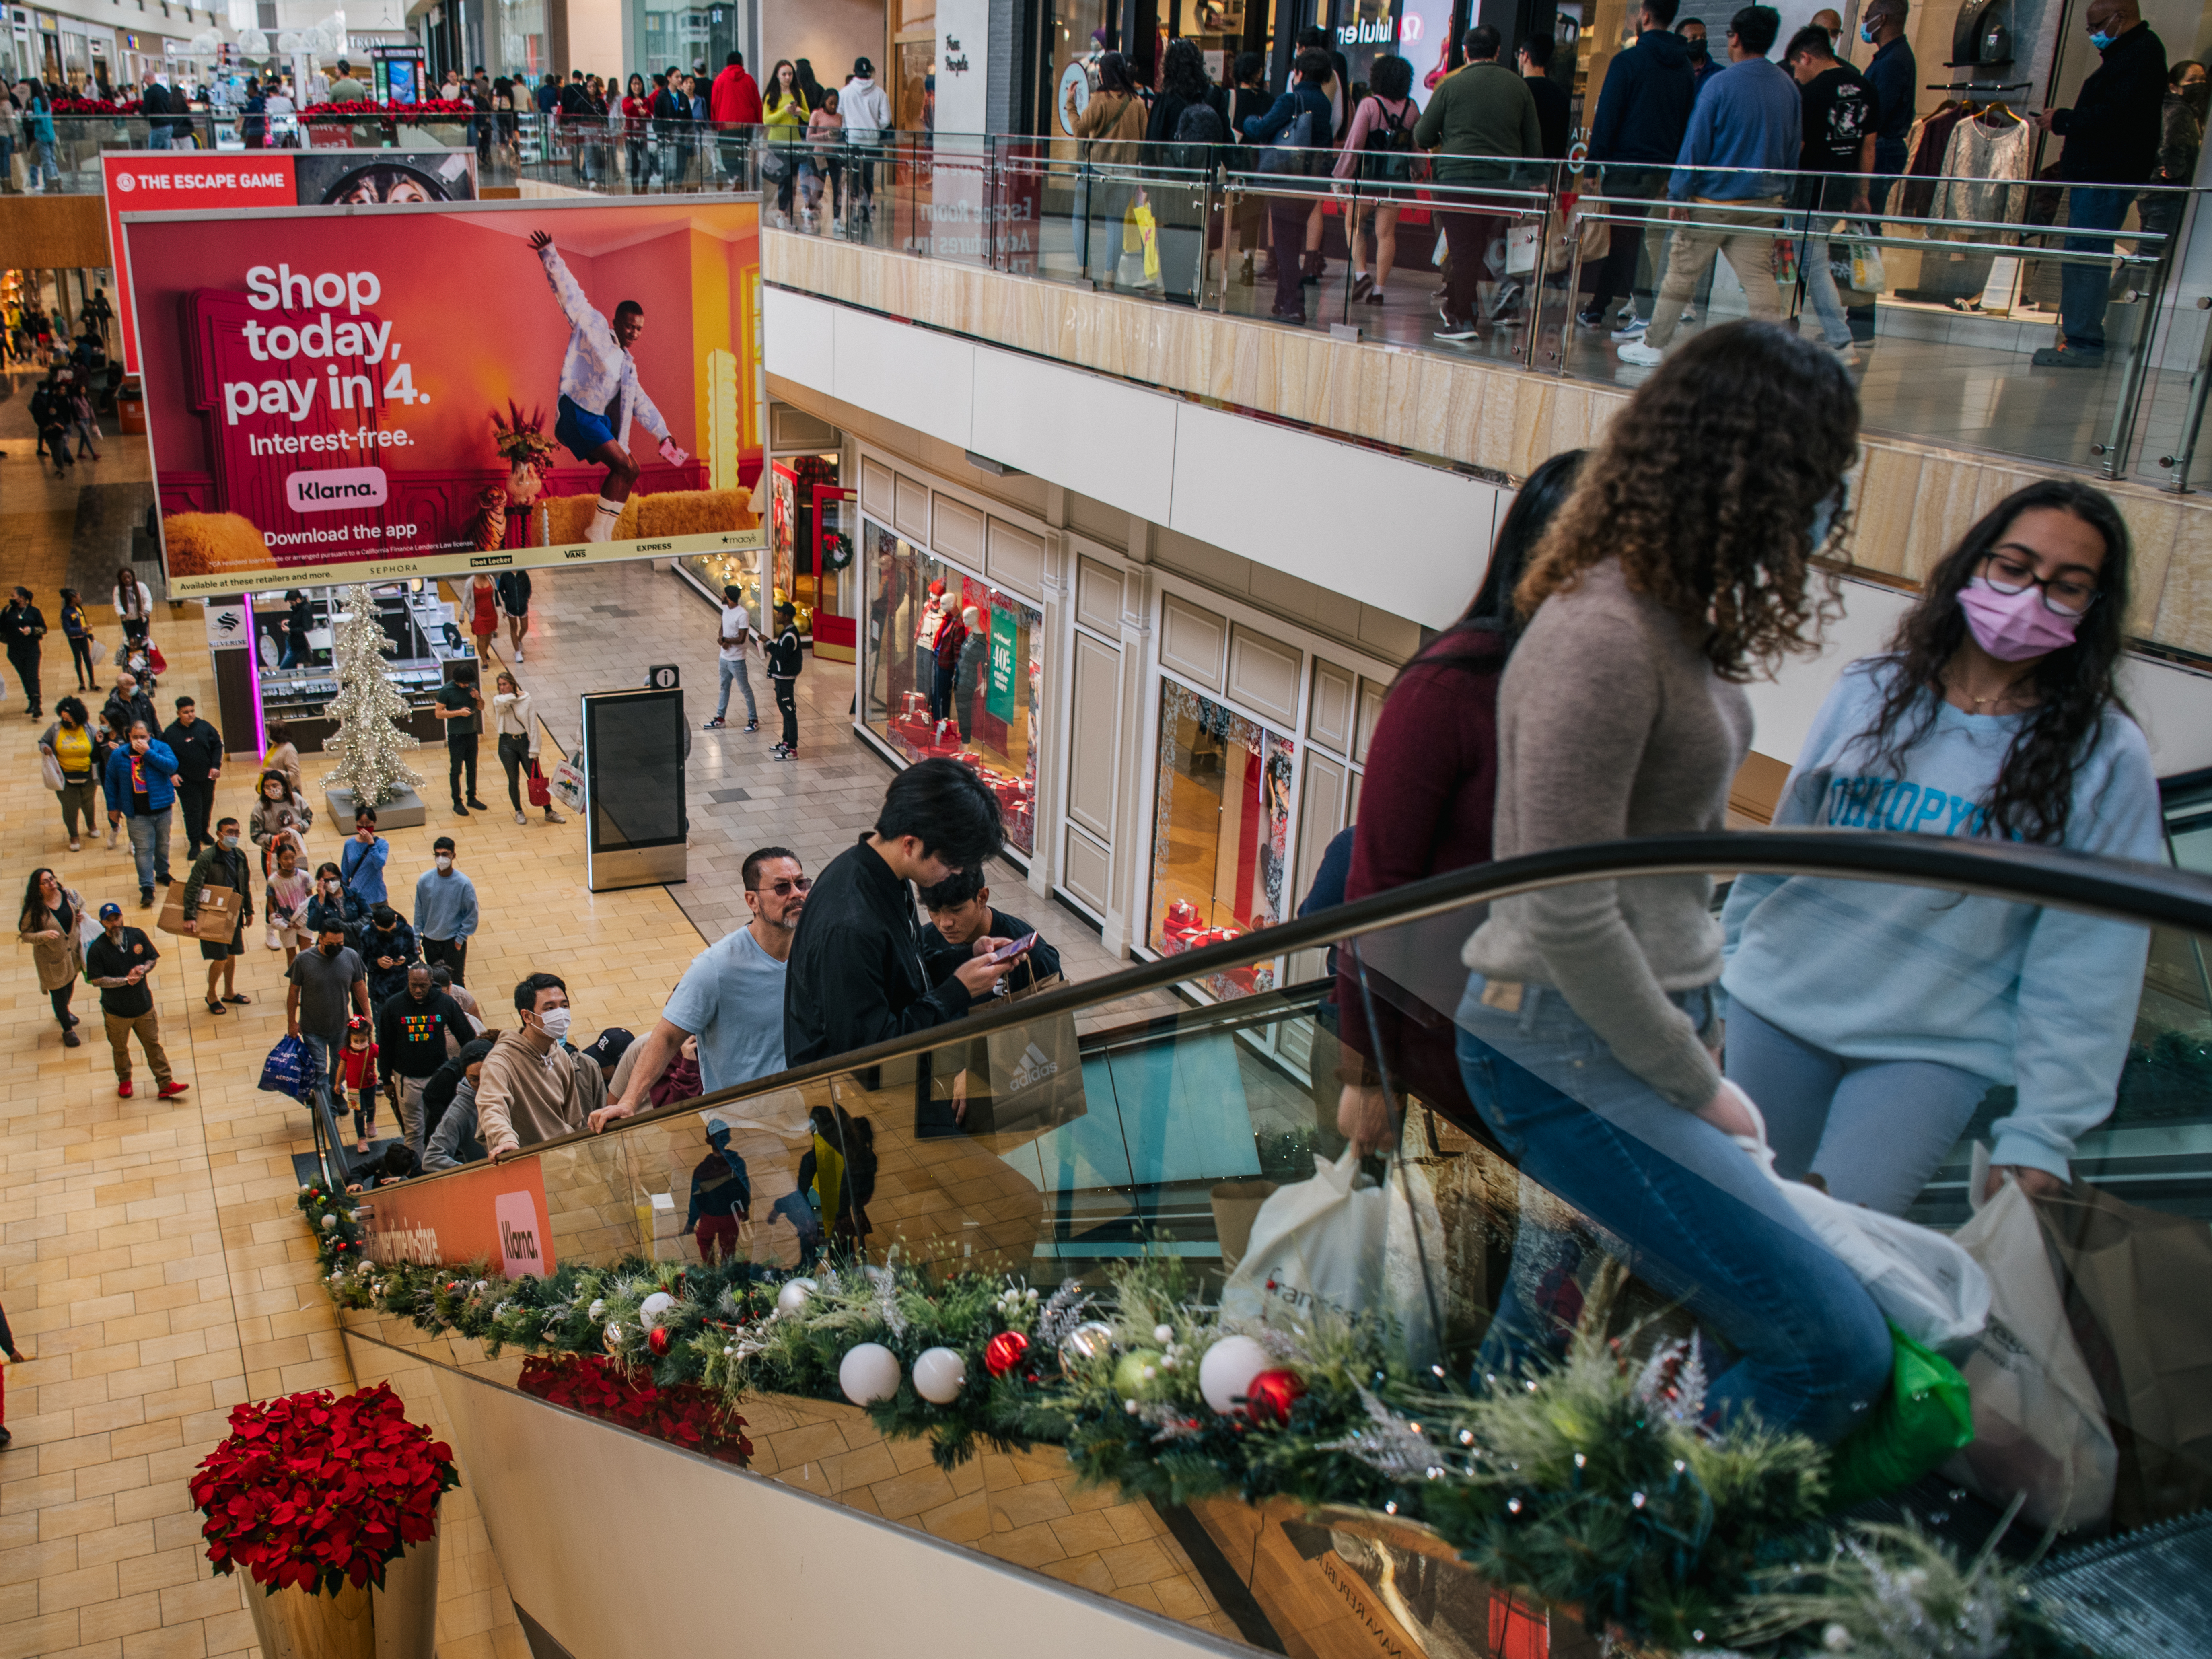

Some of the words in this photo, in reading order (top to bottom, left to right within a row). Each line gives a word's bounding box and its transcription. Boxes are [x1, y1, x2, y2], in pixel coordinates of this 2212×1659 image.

[946, 33, 960, 51] Free
[945, 53, 969, 77] People
[138, 174, 171, 190] THE
[173, 174, 237, 189] ESCAPE
[240, 173, 284, 188] GAME
[246, 263, 381, 315] Shop
[242, 313, 401, 364] today,
[224, 378, 318, 426] pay
[327, 364, 373, 410] in
[383, 363, 431, 405] 4.
[249, 426, 414, 456] Interest-free.
[298, 482, 377, 501] Klarna.
[264, 526, 349, 547] Download
[352, 524, 381, 539] the
[385, 523, 417, 540] app
[292, 552, 320, 561] arranged
[321, 550, 348, 559] pursuant
[362, 547, 389, 555] California
[390, 545, 414, 553] Finance
[414, 543, 440, 551] Lenders
[564, 549, 586, 559] VANS
[636, 543, 672, 552] EXPRESS
[370, 564, 418, 575] SEPHORA
[488, 556, 511, 565] Locker
[180, 581, 218, 591] Available
[230, 578, 253, 587] these
[255, 574, 290, 584] retailers
[291, 572, 308, 581] and
[309, 571, 333, 580] more.
[994, 679, 1008, 693] store
[401, 1014, 442, 1024] STUDYING
[408, 1024, 434, 1033] NEVER
[409, 1033, 434, 1041] STOPS
[1010, 1062, 1058, 1091] adidas
[501, 1221, 538, 1260] Klarna.
